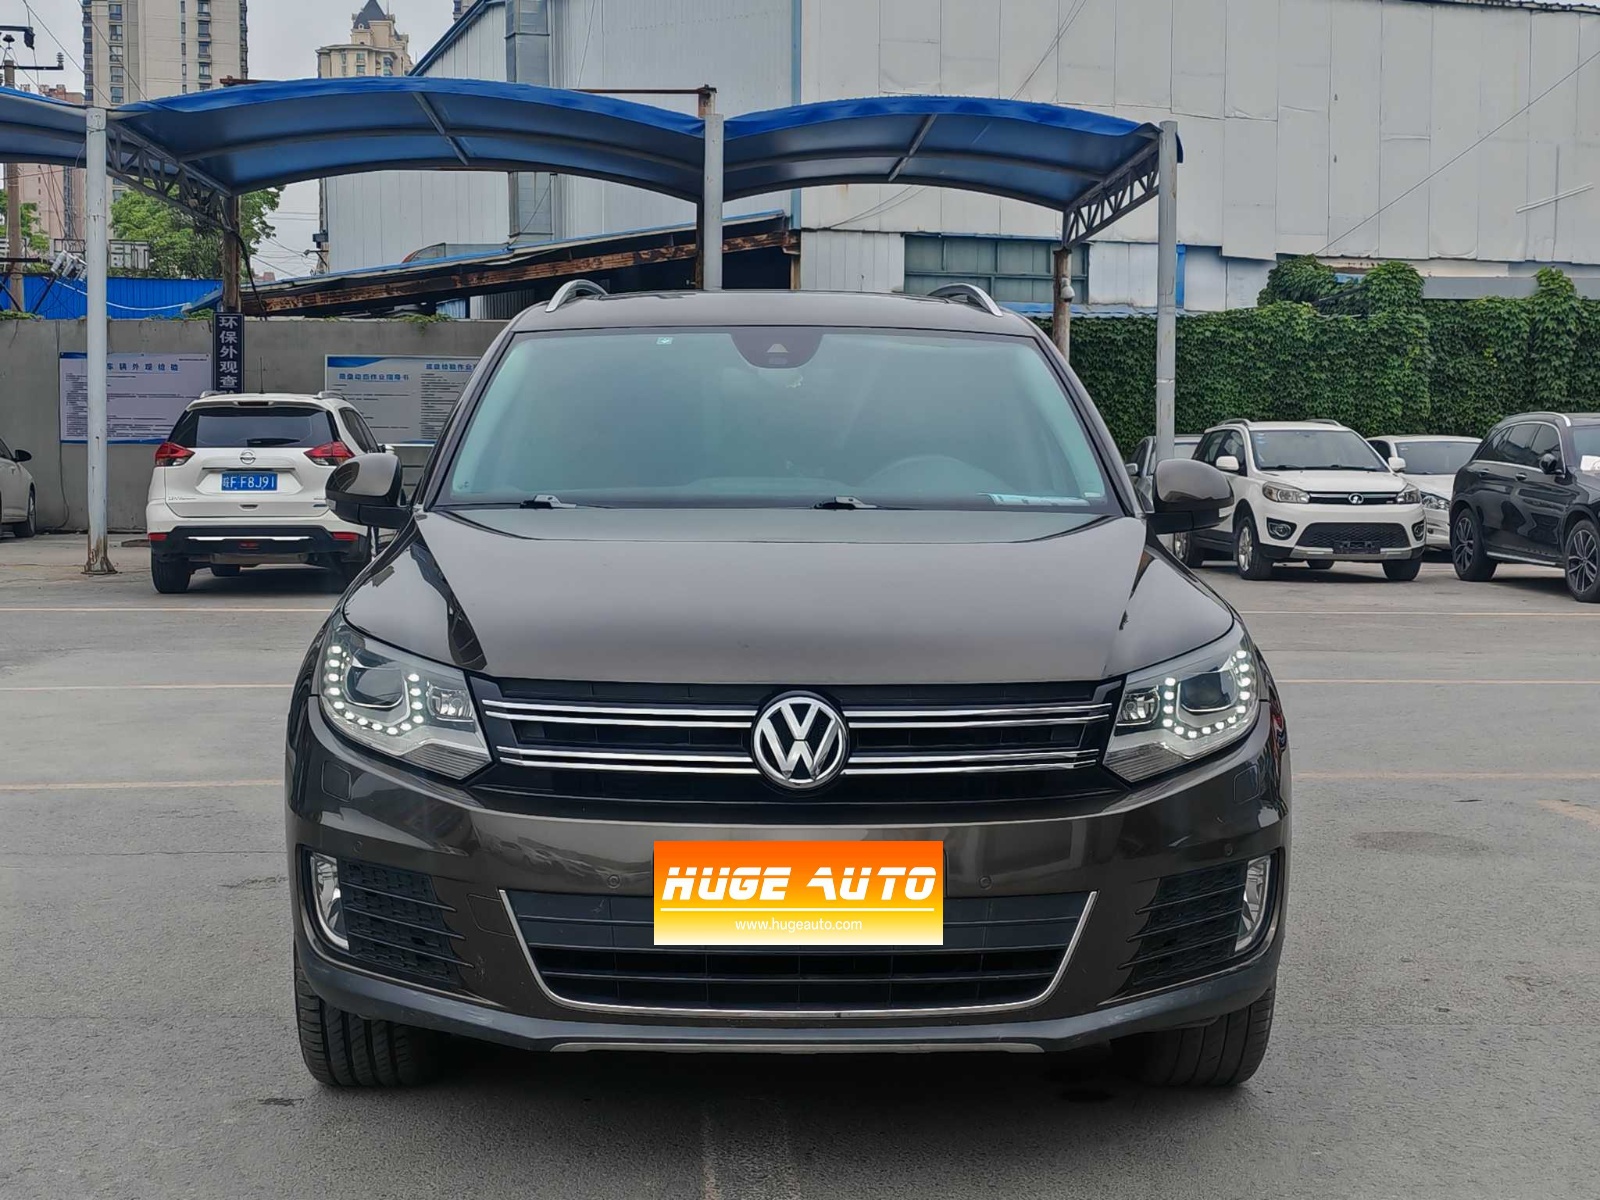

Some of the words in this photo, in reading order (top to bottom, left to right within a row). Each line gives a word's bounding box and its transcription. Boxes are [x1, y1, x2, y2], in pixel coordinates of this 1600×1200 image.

[219, 316, 238, 393] 环保外观查
